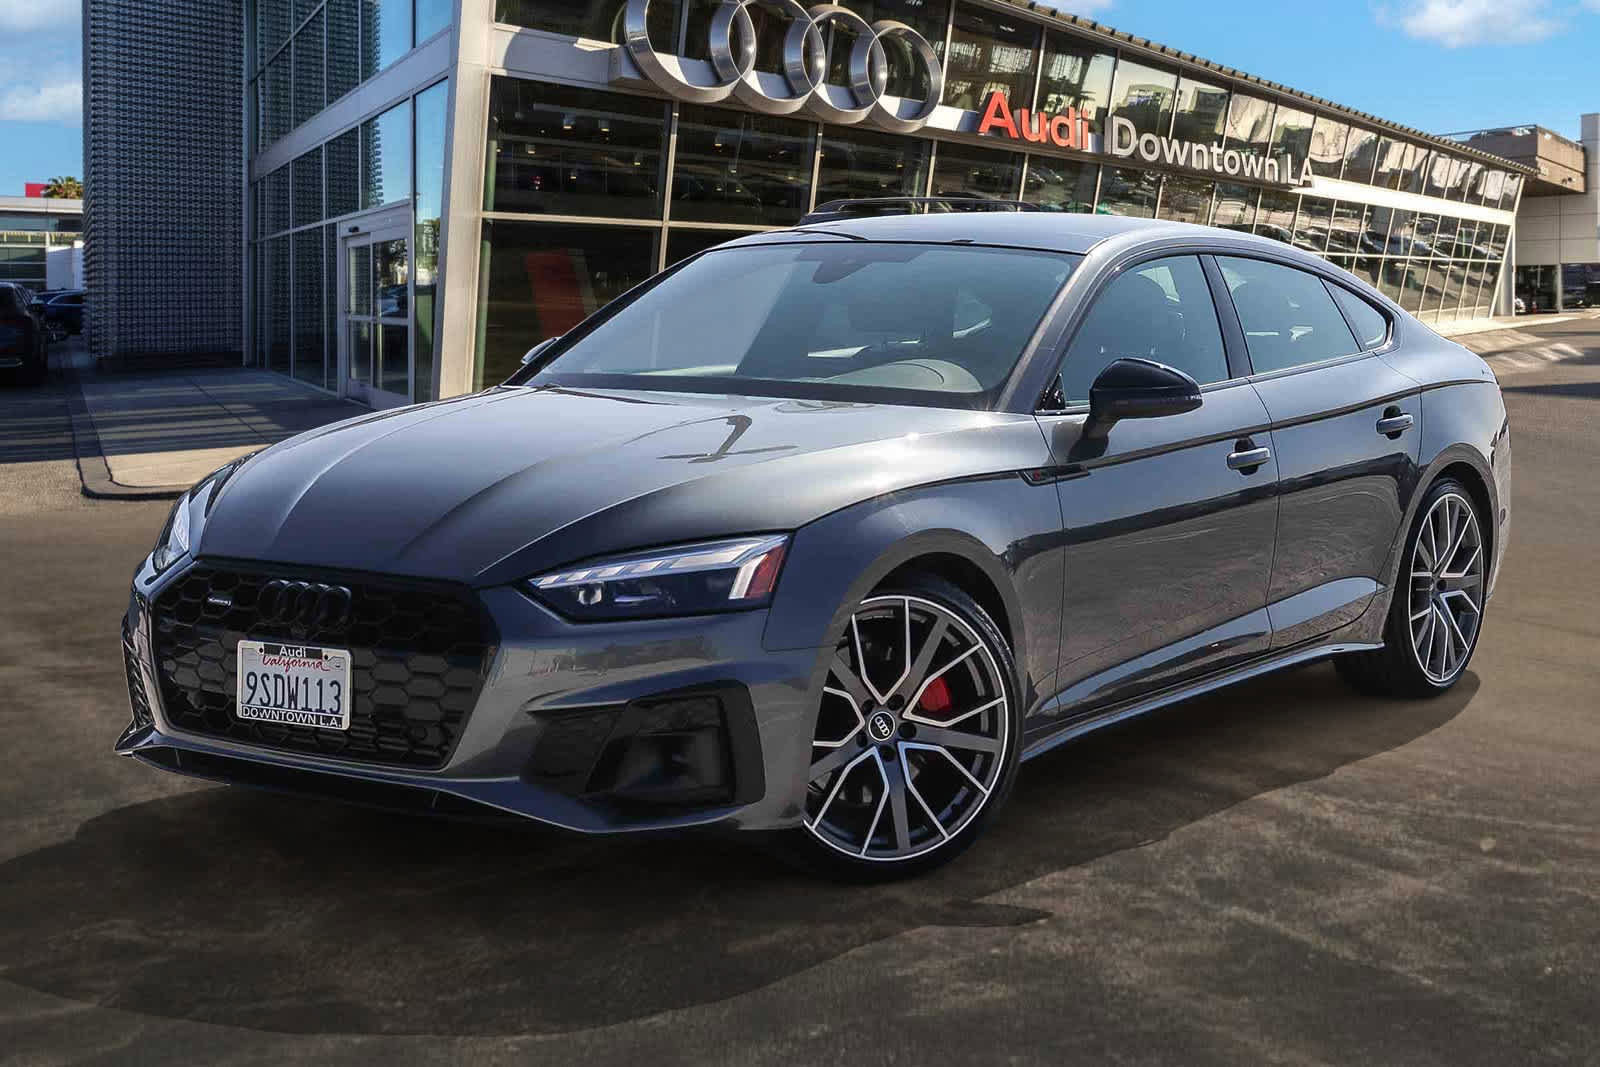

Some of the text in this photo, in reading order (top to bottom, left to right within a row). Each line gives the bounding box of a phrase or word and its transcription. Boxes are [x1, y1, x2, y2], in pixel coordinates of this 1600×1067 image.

[978, 91, 1316, 188] Audi Downtown LA
[279, 646, 306, 657] Audi
[246, 671, 341, 715] 9SDW113
[243, 707, 342, 728] DOWNTOWN L.A.
